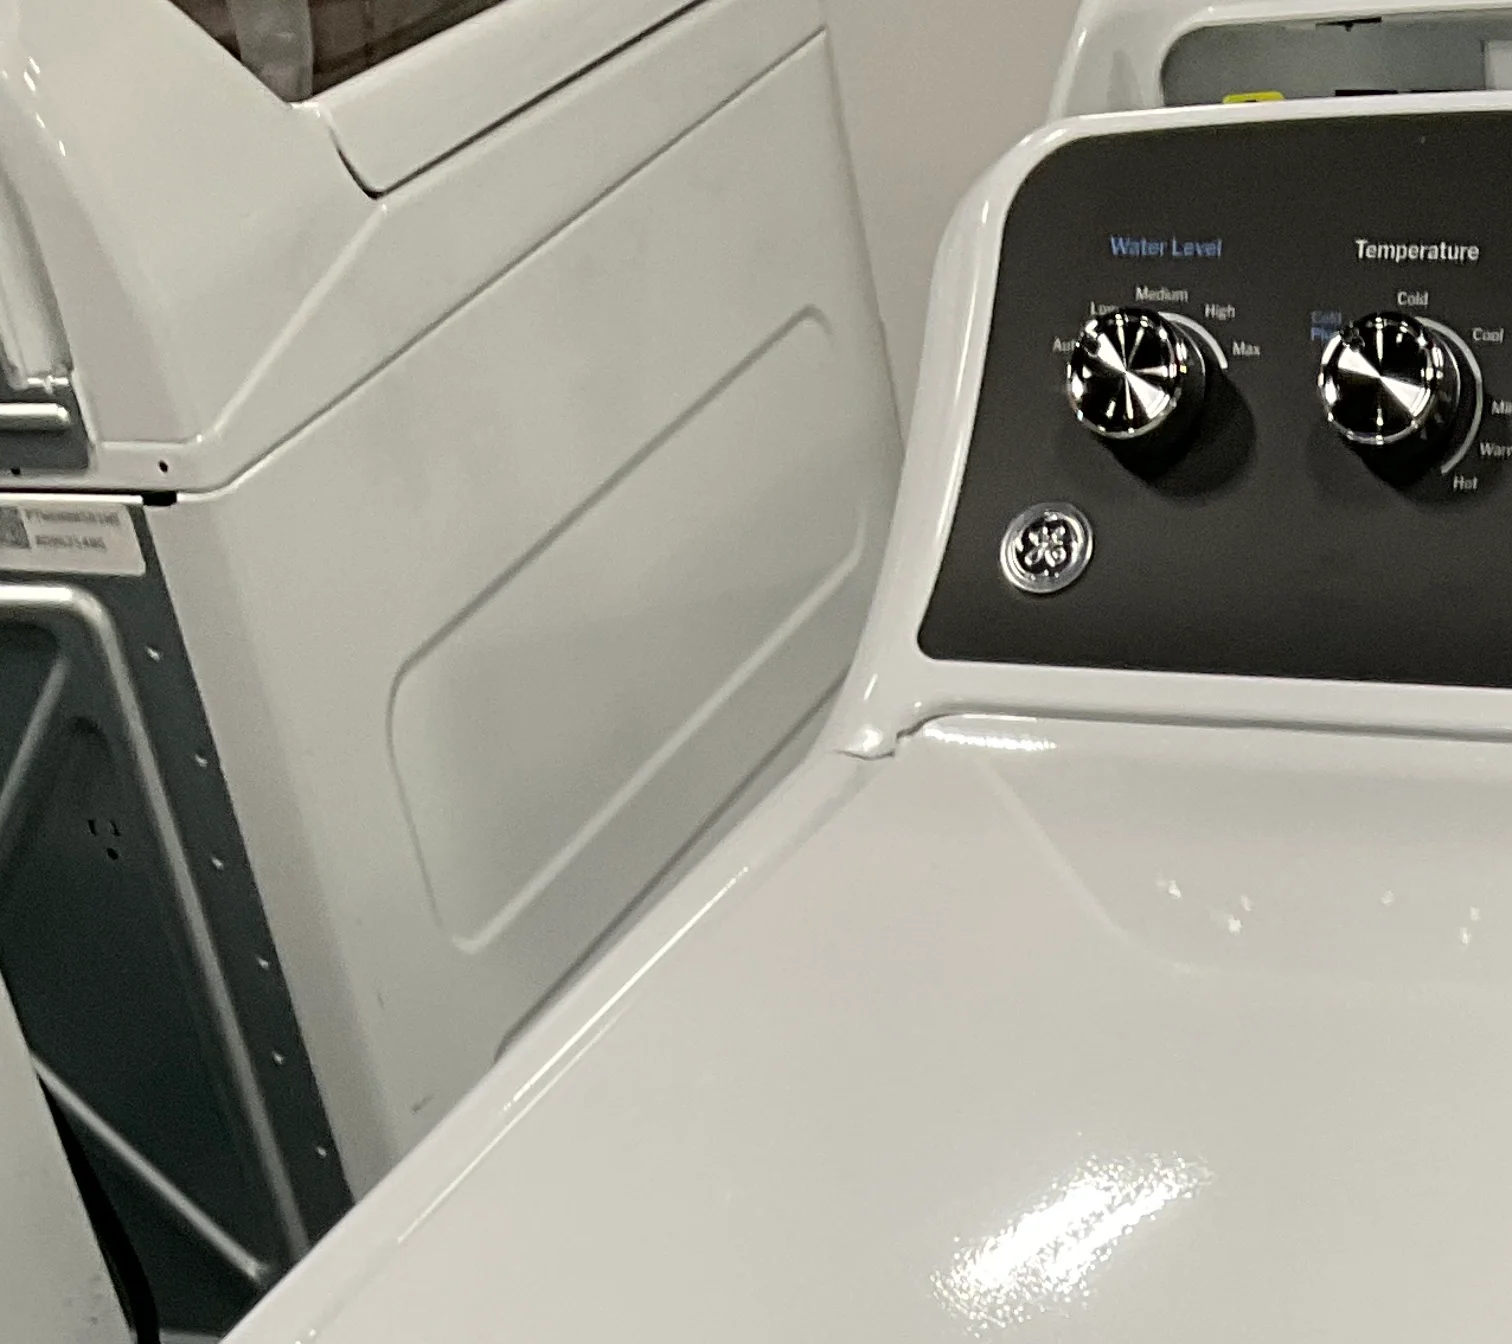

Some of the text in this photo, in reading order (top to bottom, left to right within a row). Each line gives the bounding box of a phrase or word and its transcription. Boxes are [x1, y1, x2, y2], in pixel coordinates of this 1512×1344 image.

[1110, 234, 1222, 258] Water Level
[1356, 238, 1480, 263] Temperature
[1135, 284, 1189, 303] Medium
[1397, 291, 1429, 307] Cold
[1205, 302, 1236, 321] High
[1472, 327, 1505, 344] Cool
[1232, 340, 1261, 357] Max
[1453, 476, 1479, 492] Hot
